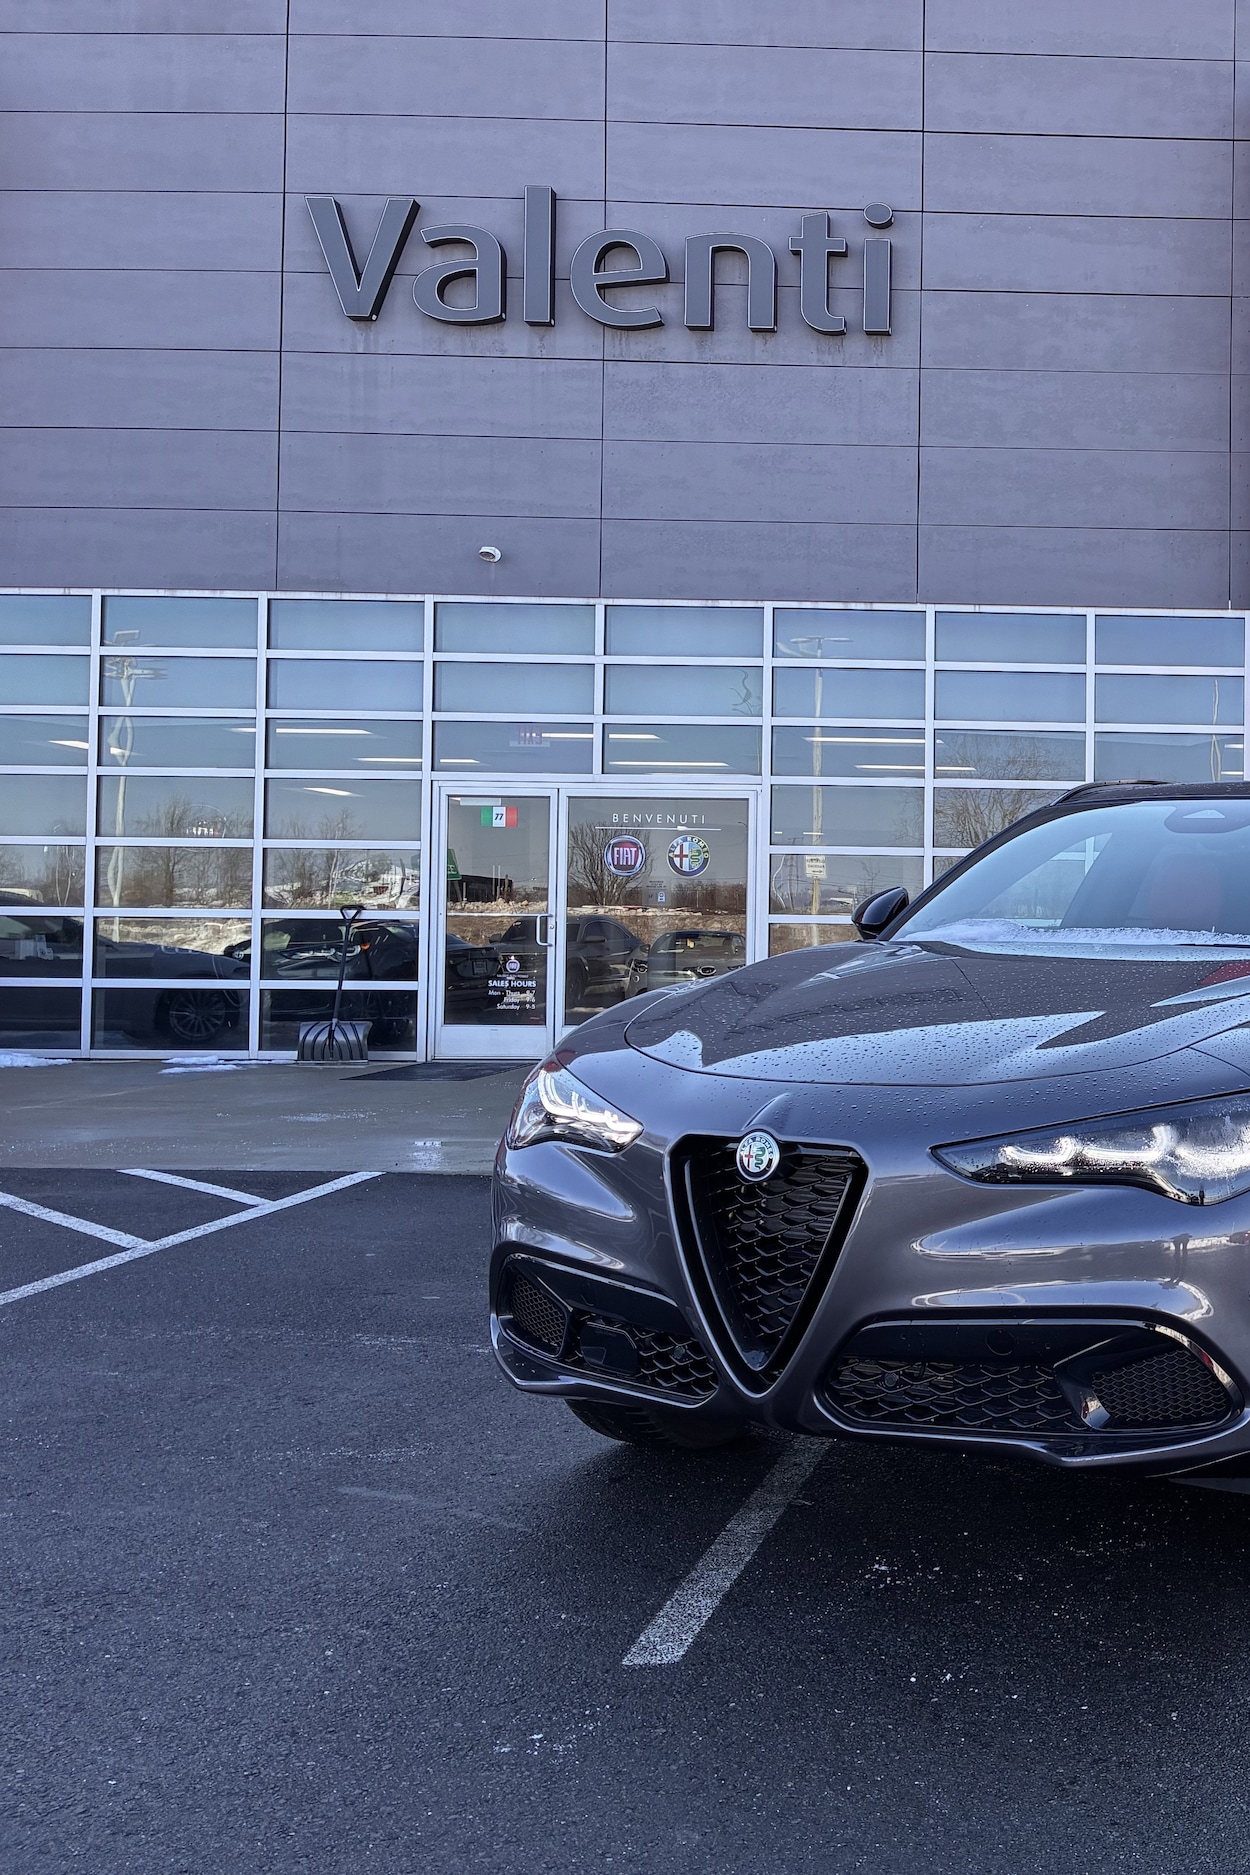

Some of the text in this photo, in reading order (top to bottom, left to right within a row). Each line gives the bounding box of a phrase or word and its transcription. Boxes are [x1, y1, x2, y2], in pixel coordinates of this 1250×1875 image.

[304, 184, 894, 336] Valenti
[494, 813, 504, 821] 77
[612, 813, 705, 824] BENVENUTI
[613, 847, 637, 866] FIAT
[668, 836, 709, 859] ALFA ROMEO
